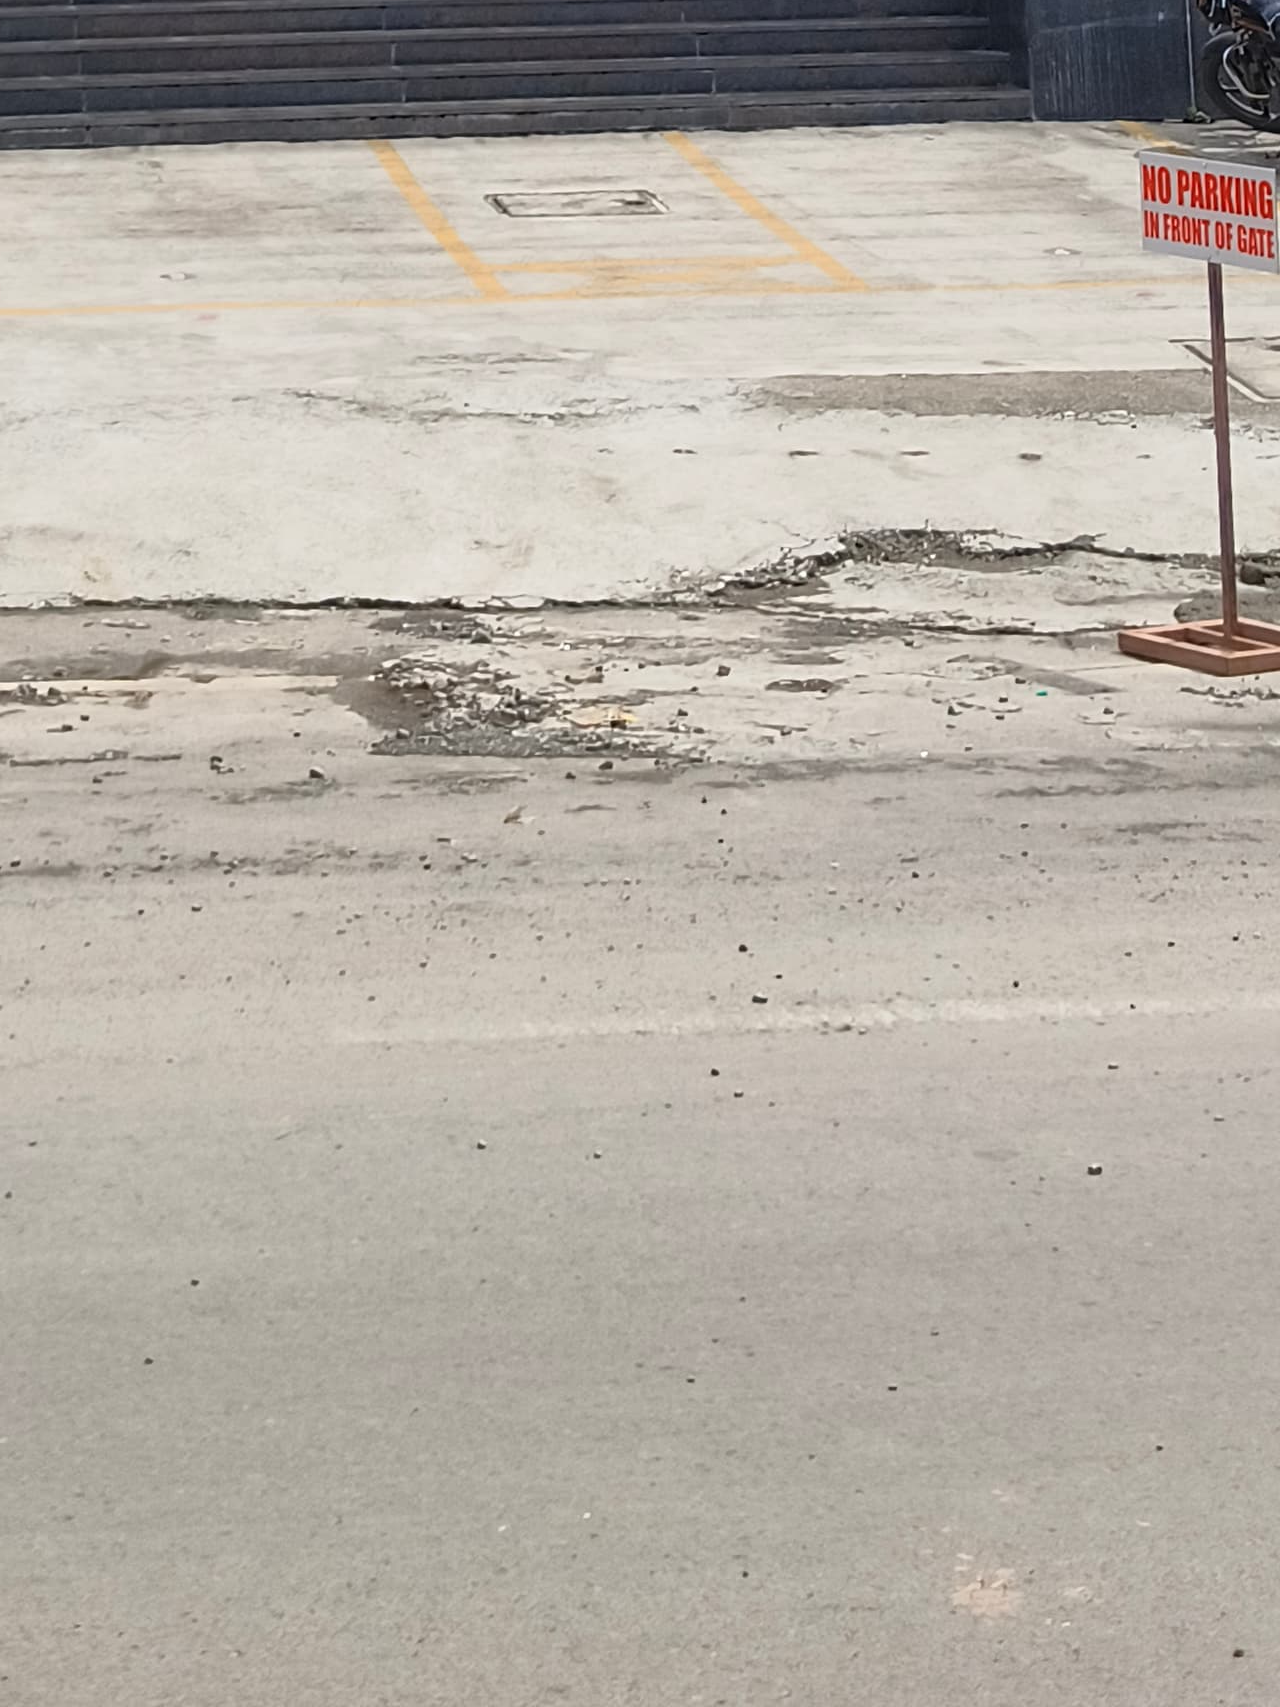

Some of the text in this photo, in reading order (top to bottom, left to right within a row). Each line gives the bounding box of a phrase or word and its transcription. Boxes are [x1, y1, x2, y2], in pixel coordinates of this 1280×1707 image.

[1142, 164, 1275, 220] NO PARKING
[1143, 209, 1275, 259] IN FRONT OF GATE
